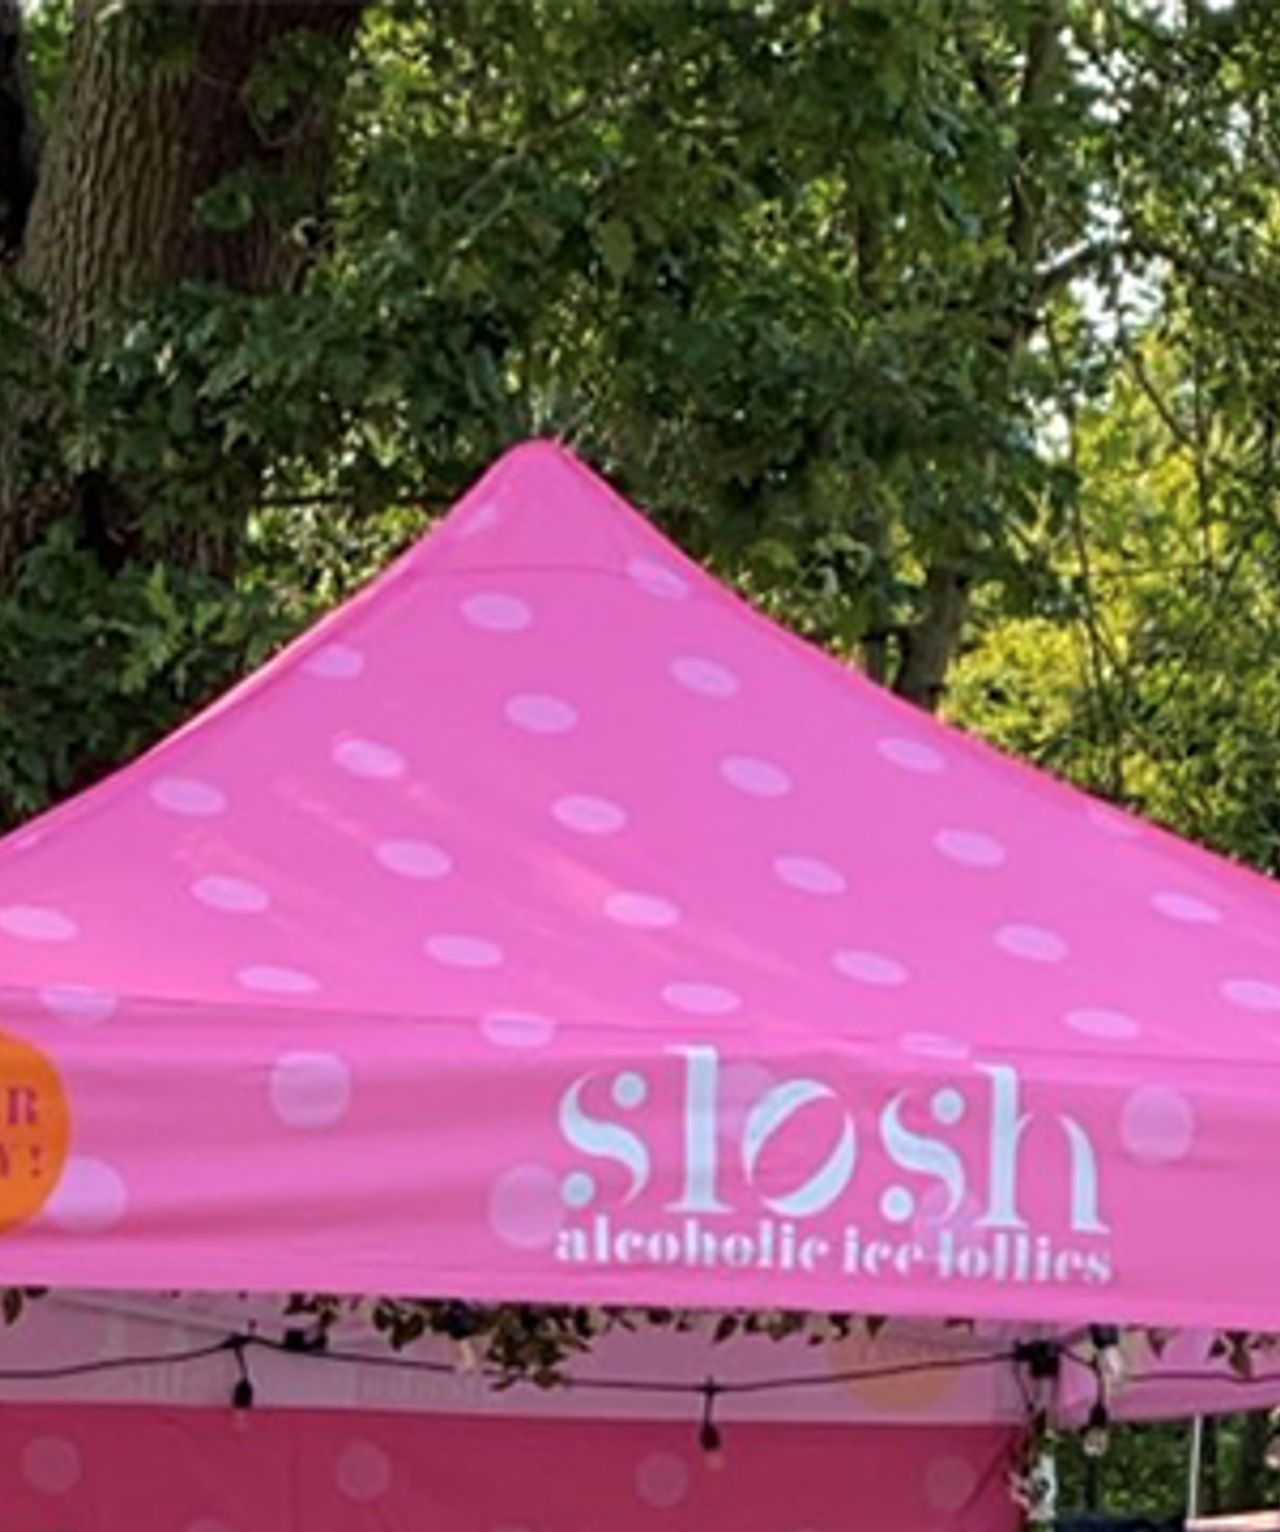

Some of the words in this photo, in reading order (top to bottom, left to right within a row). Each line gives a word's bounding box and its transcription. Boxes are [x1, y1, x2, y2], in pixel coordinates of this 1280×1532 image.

[558, 1043, 1111, 1234] slosh
[554, 1214, 828, 1273] alcoholic
[843, 1225, 921, 1275] ice
[936, 1228, 1112, 1284] lollies
